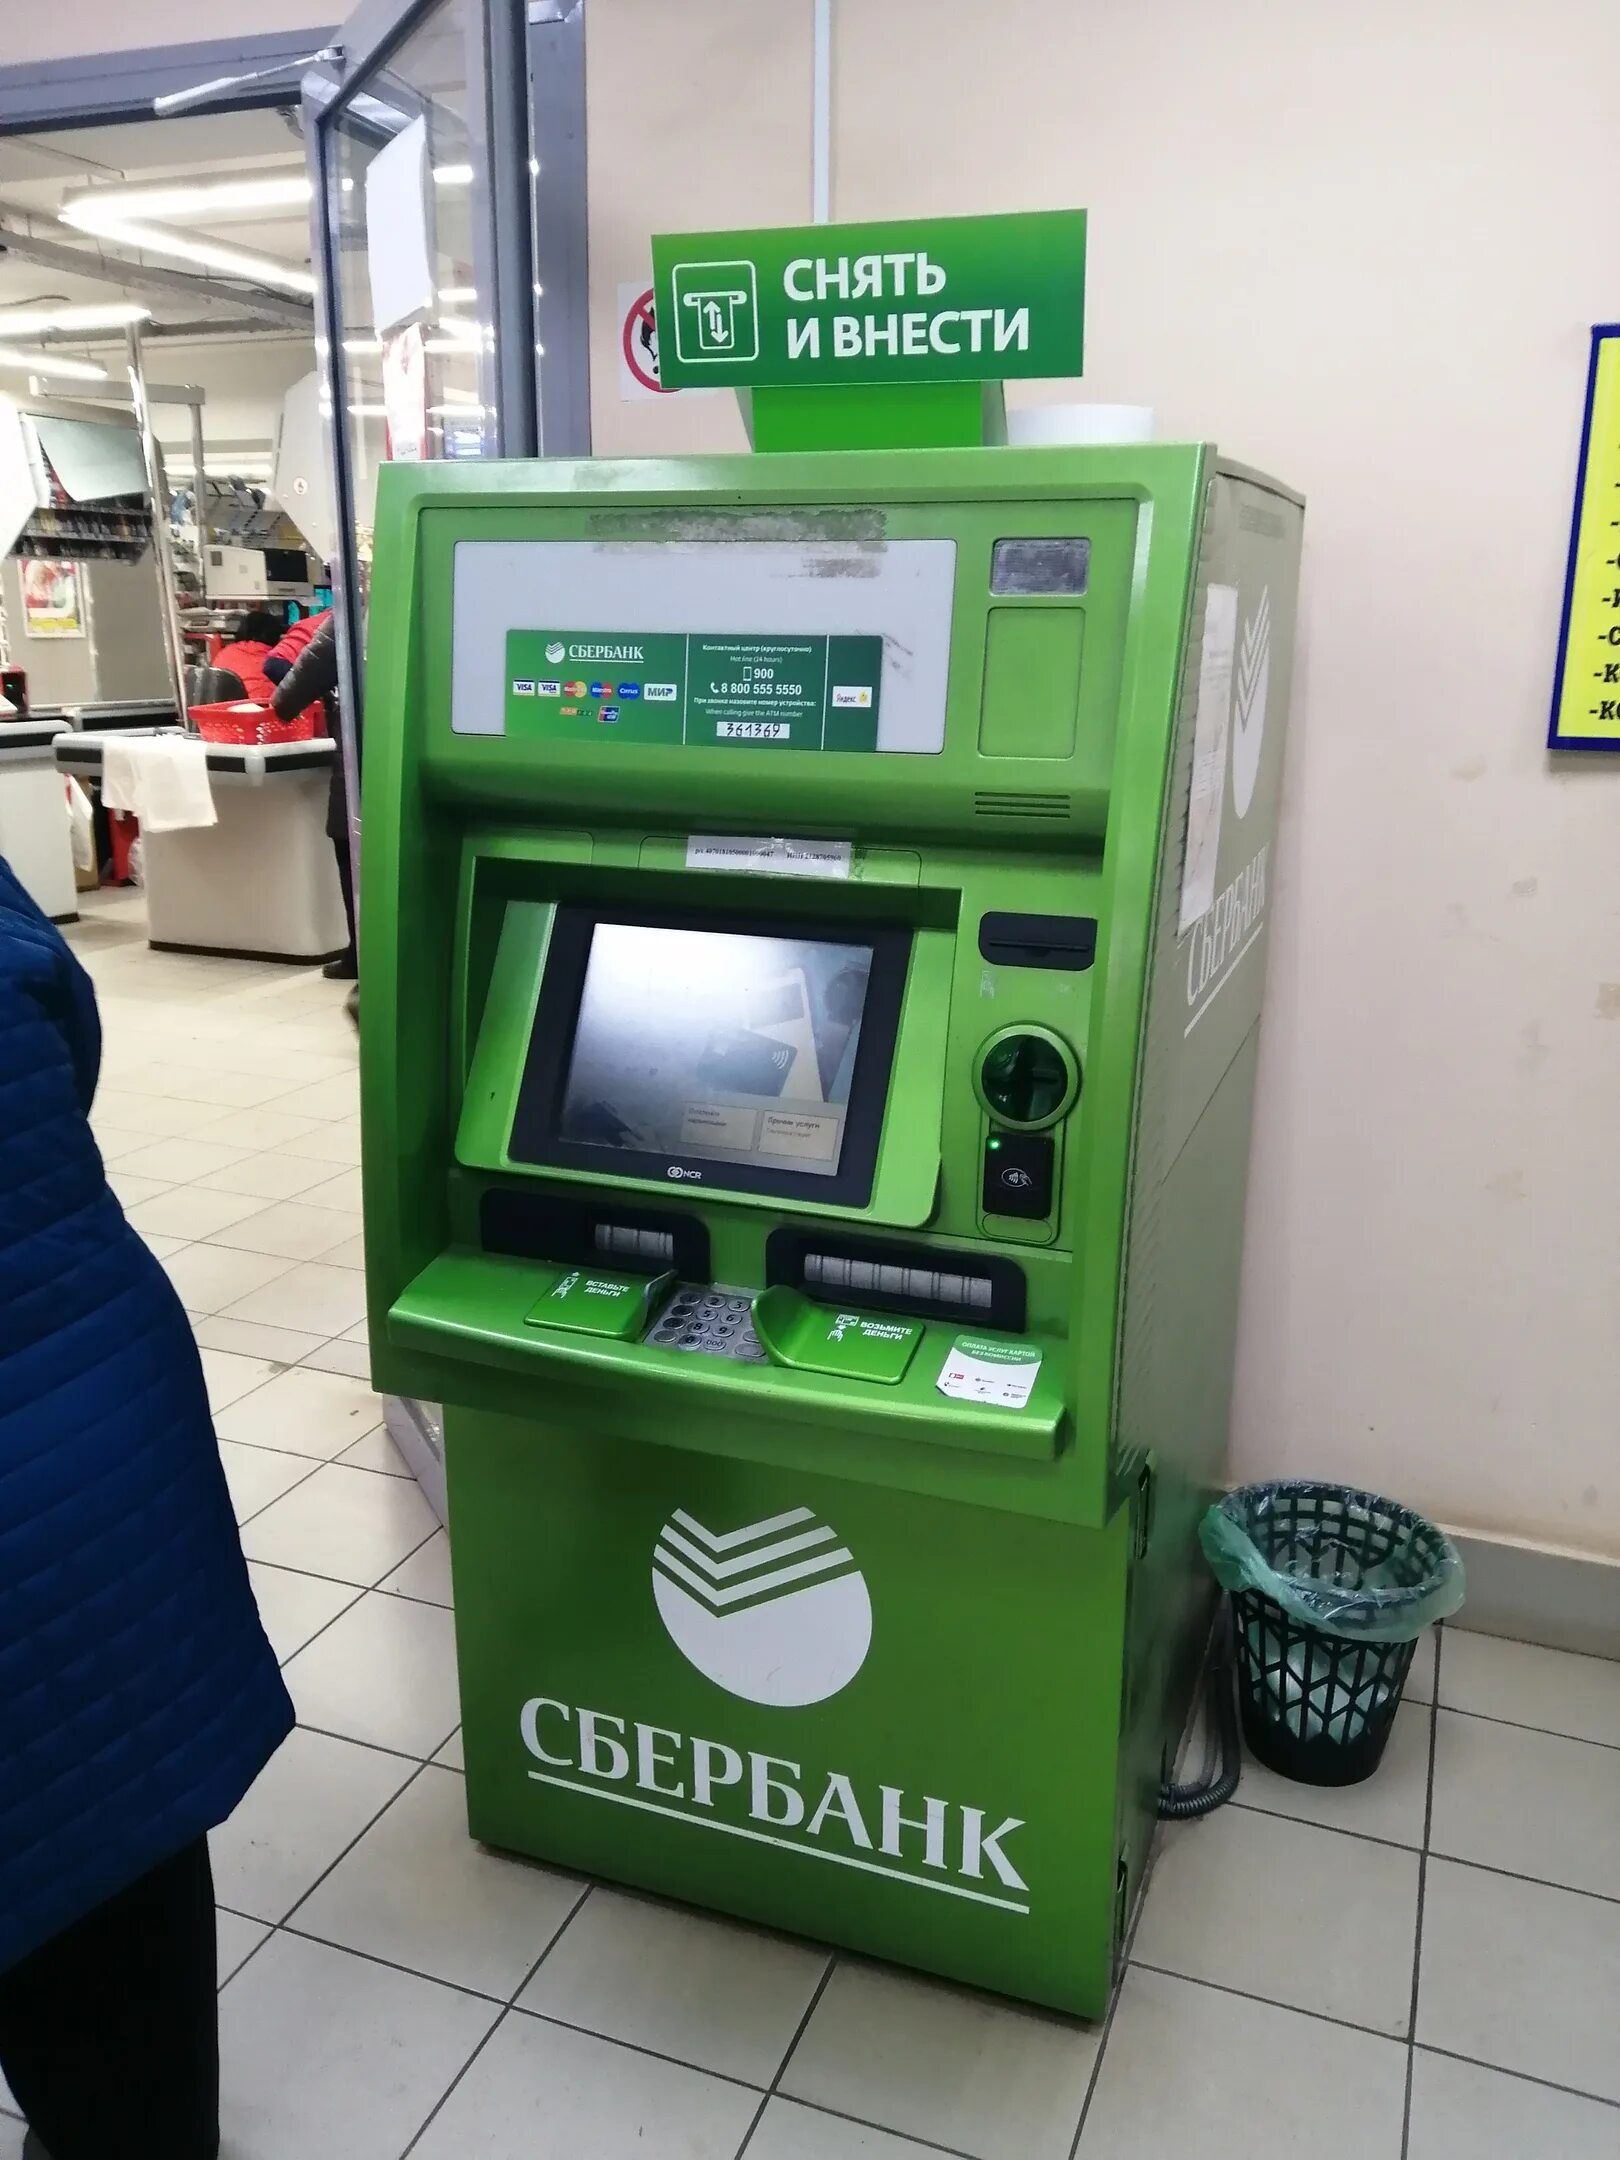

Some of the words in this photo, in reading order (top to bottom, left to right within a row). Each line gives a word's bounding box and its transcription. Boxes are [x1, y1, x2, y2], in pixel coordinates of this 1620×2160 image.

[783, 252, 946, 302] СНЯТЬ
[787, 318, 821, 359] И
[833, 308, 1030, 358] ВНЕСТИ
[568, 644, 645, 660] СБЕРБАНК
[754, 668, 774, 679] 900
[541, 684, 557, 692] VISA
[648, 688, 673, 697] МИР
[721, 683, 728, 693] 8
[731, 683, 750, 694] 800
[753, 684, 773, 694] 555
[775, 684, 802, 695] 5550
[726, 723, 780, 737] 361369
[683, 1170, 702, 1180] NCR
[586, 1280, 630, 1292] ВСТАВЬТЕ
[585, 1287, 621, 1298] ДЕНЬГИ
[860, 1321, 913, 1335] ВОЗЬМИТЕ
[862, 1330, 904, 1341] ДЕНЬГИ
[519, 1696, 1029, 1891] СБЕРБАНК
